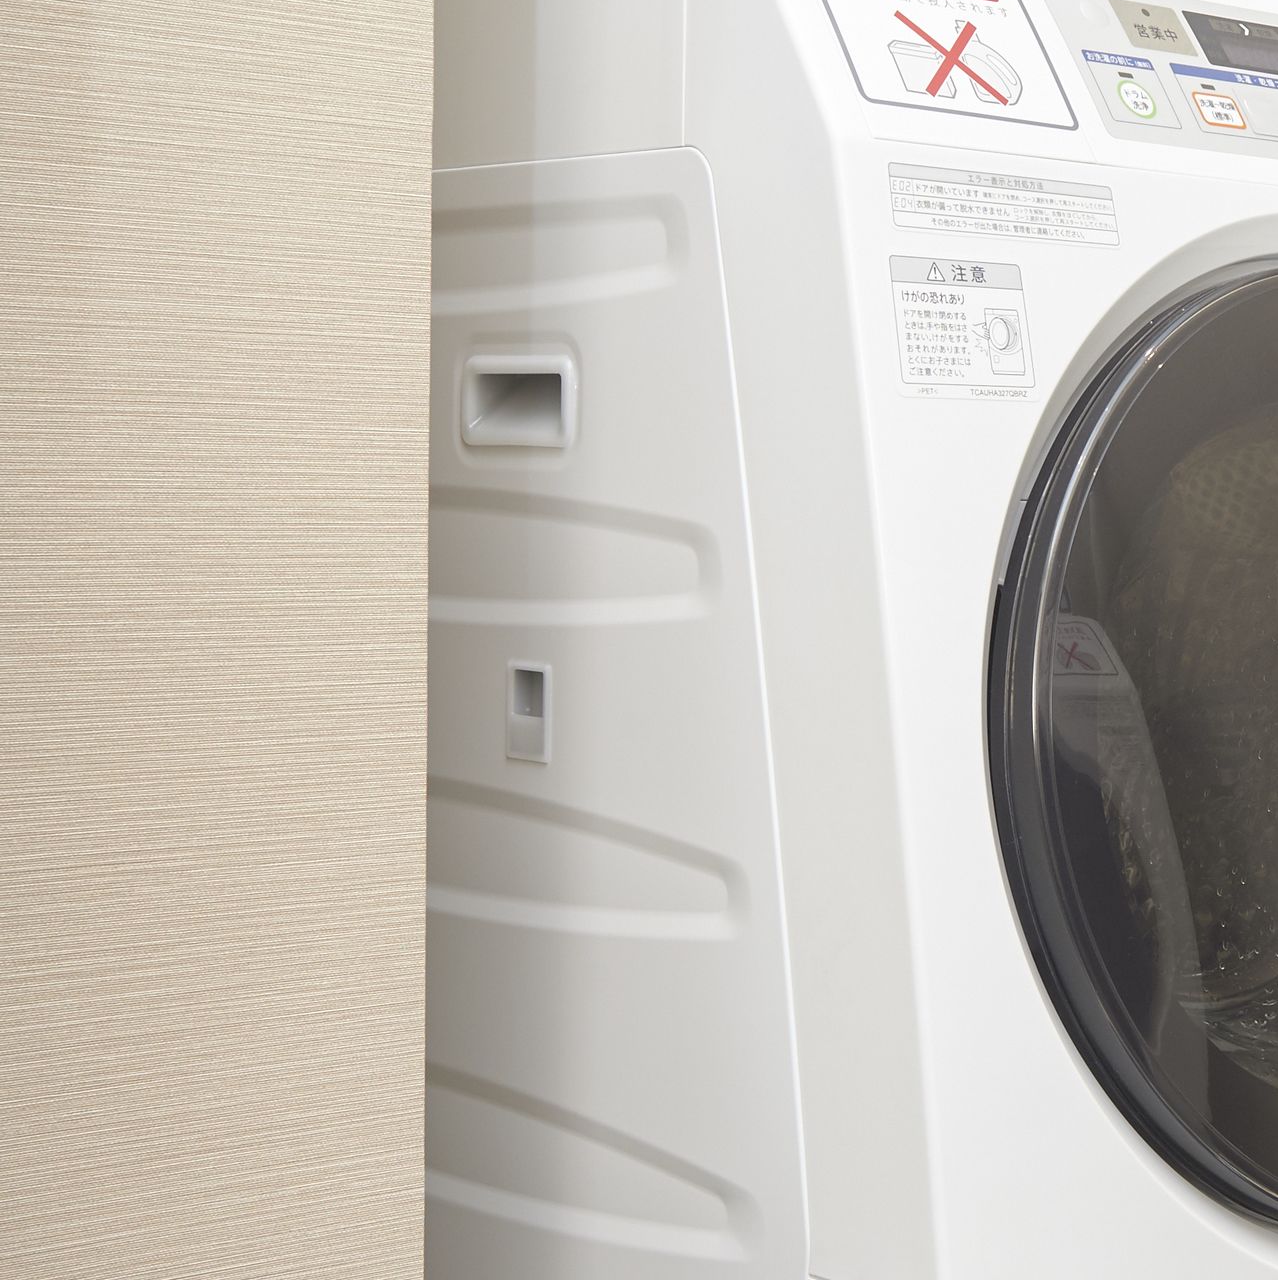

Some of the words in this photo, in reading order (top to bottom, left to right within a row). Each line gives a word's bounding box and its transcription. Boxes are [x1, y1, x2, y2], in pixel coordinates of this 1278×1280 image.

[1134, 23, 1177, 42] 営業中
[1124, 88, 1148, 100] ドラム
[1133, 100, 1149, 111] 洗浄
[915, 184, 978, 197] ドアが開いています
[952, 264, 986, 283] 注意
[902, 290, 964, 304] けがの恐れあり
[904, 310, 966, 320] ドアを開け閉めする
[907, 344, 970, 355] おそれがあります。
[908, 355, 971, 366] とくにお子さまには
[909, 367, 964, 378] ご注意ください。
